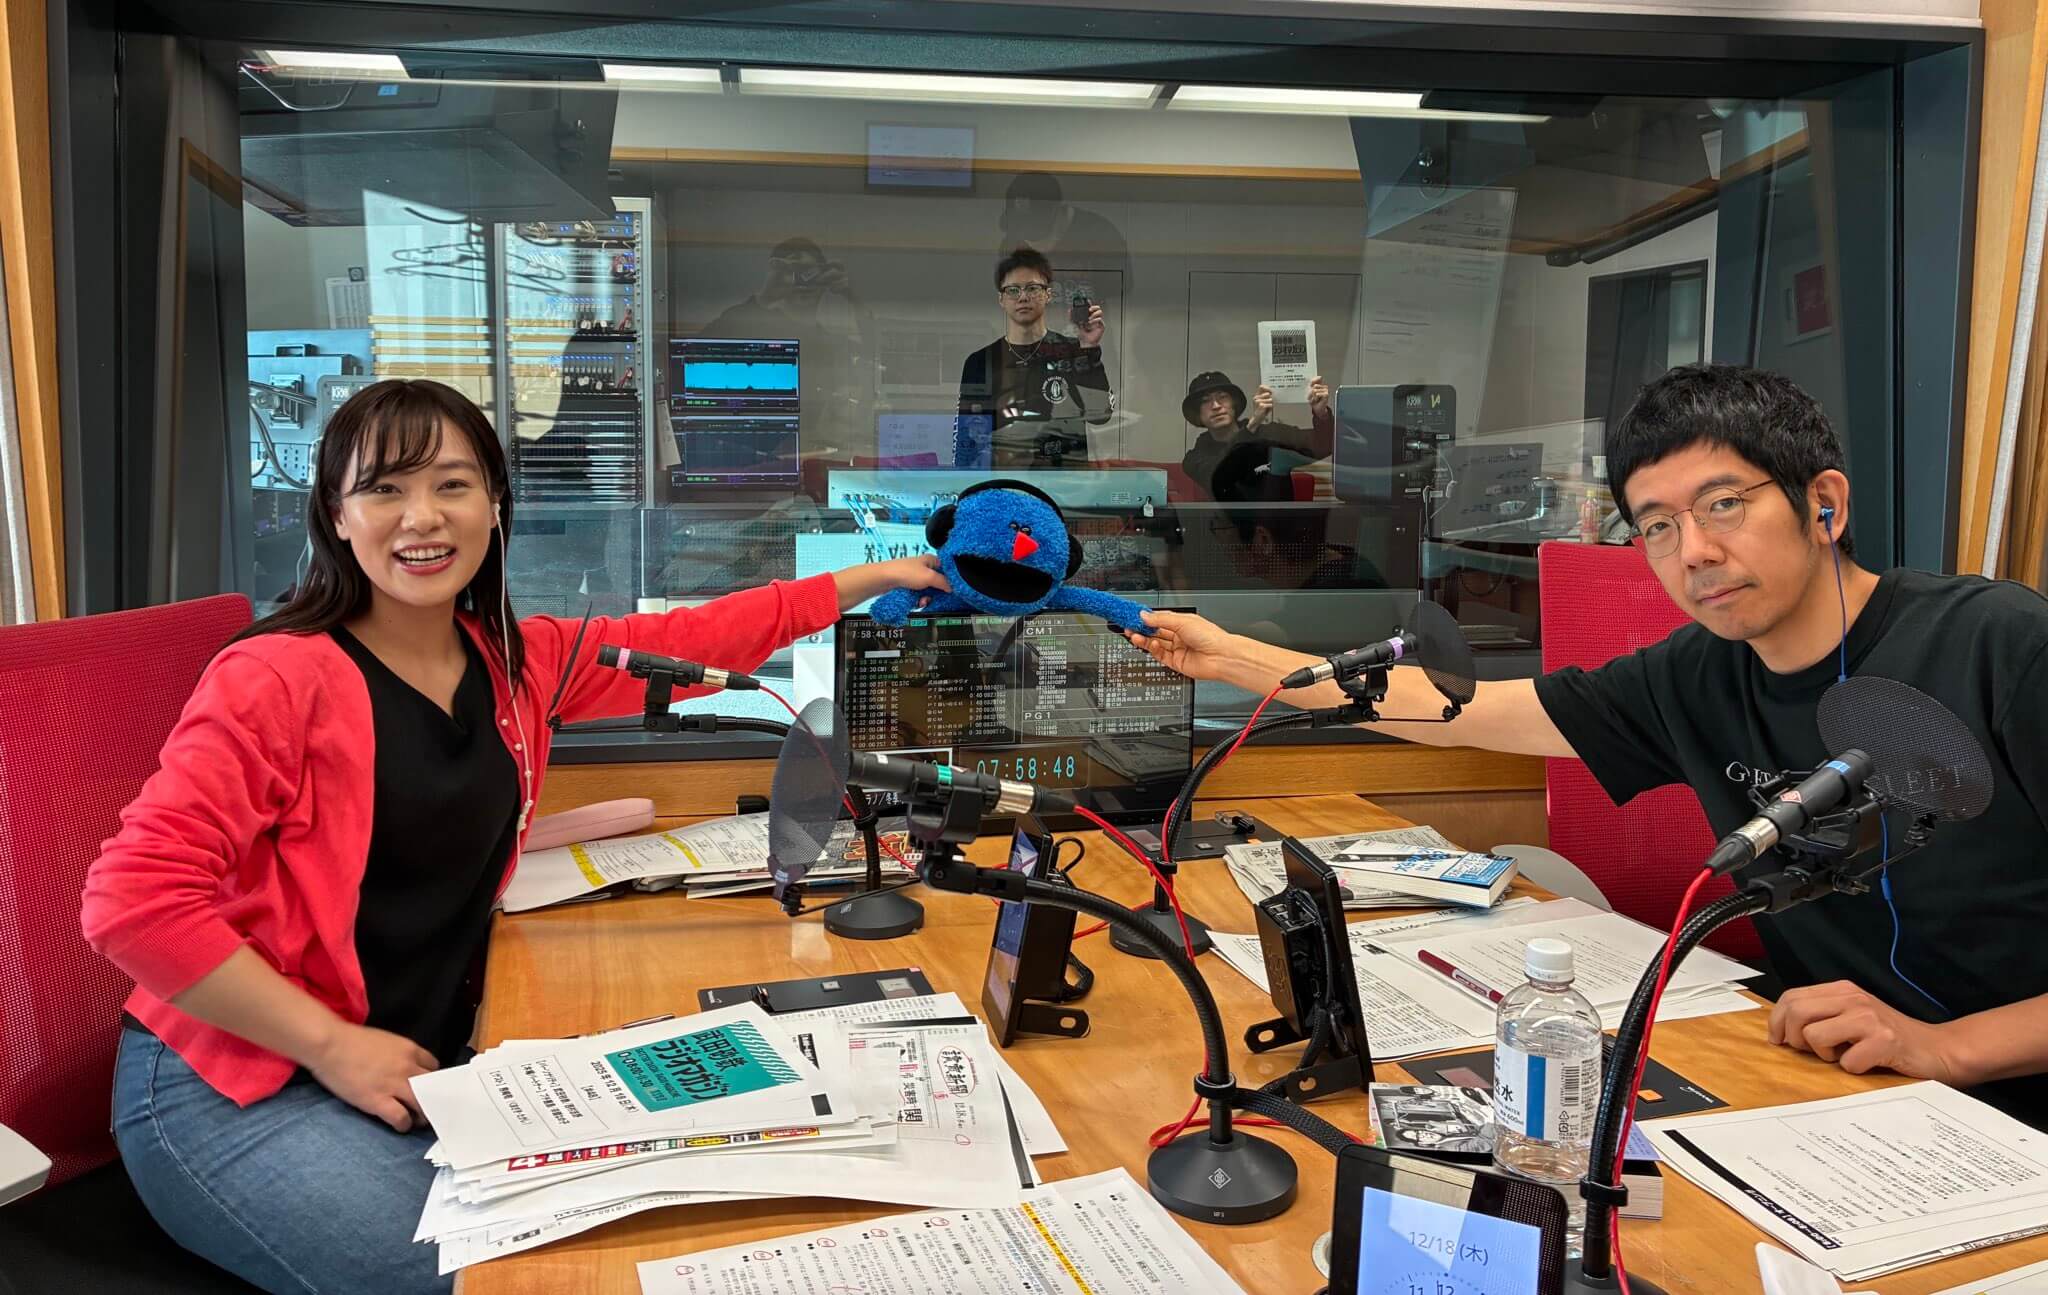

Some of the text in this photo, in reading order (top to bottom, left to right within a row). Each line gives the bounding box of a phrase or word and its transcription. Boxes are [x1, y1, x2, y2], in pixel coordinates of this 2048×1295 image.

[976, 755, 1076, 782] 07:58:48
[653, 1039, 729, 1100] ラジオマガジン
[692, 1029, 748, 1072] 武田砂鉄
